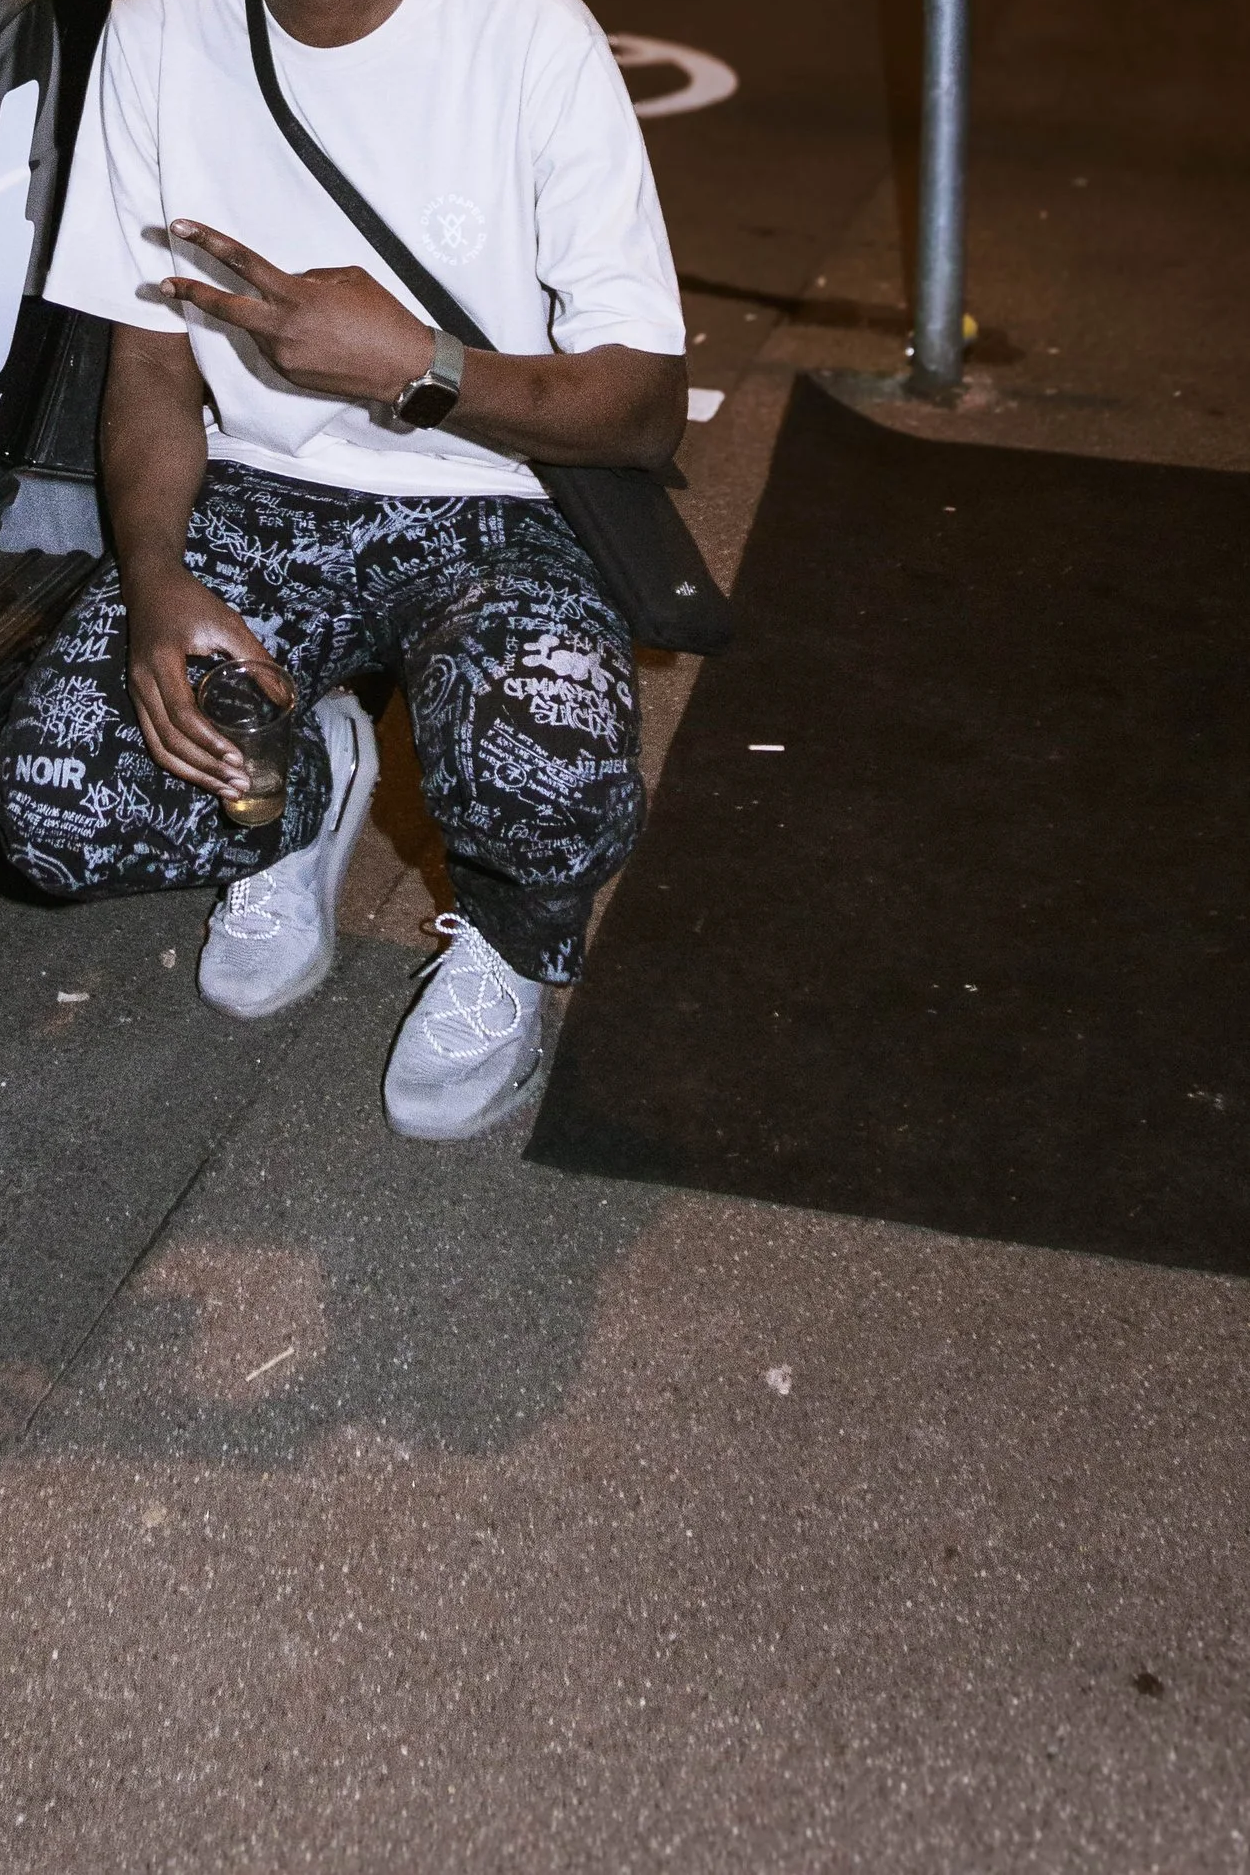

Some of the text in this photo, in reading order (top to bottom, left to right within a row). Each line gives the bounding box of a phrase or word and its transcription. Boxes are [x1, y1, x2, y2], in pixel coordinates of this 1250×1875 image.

[420, 194, 485, 225] DAILY PAPER
[15, 754, 86, 791] NOIR
